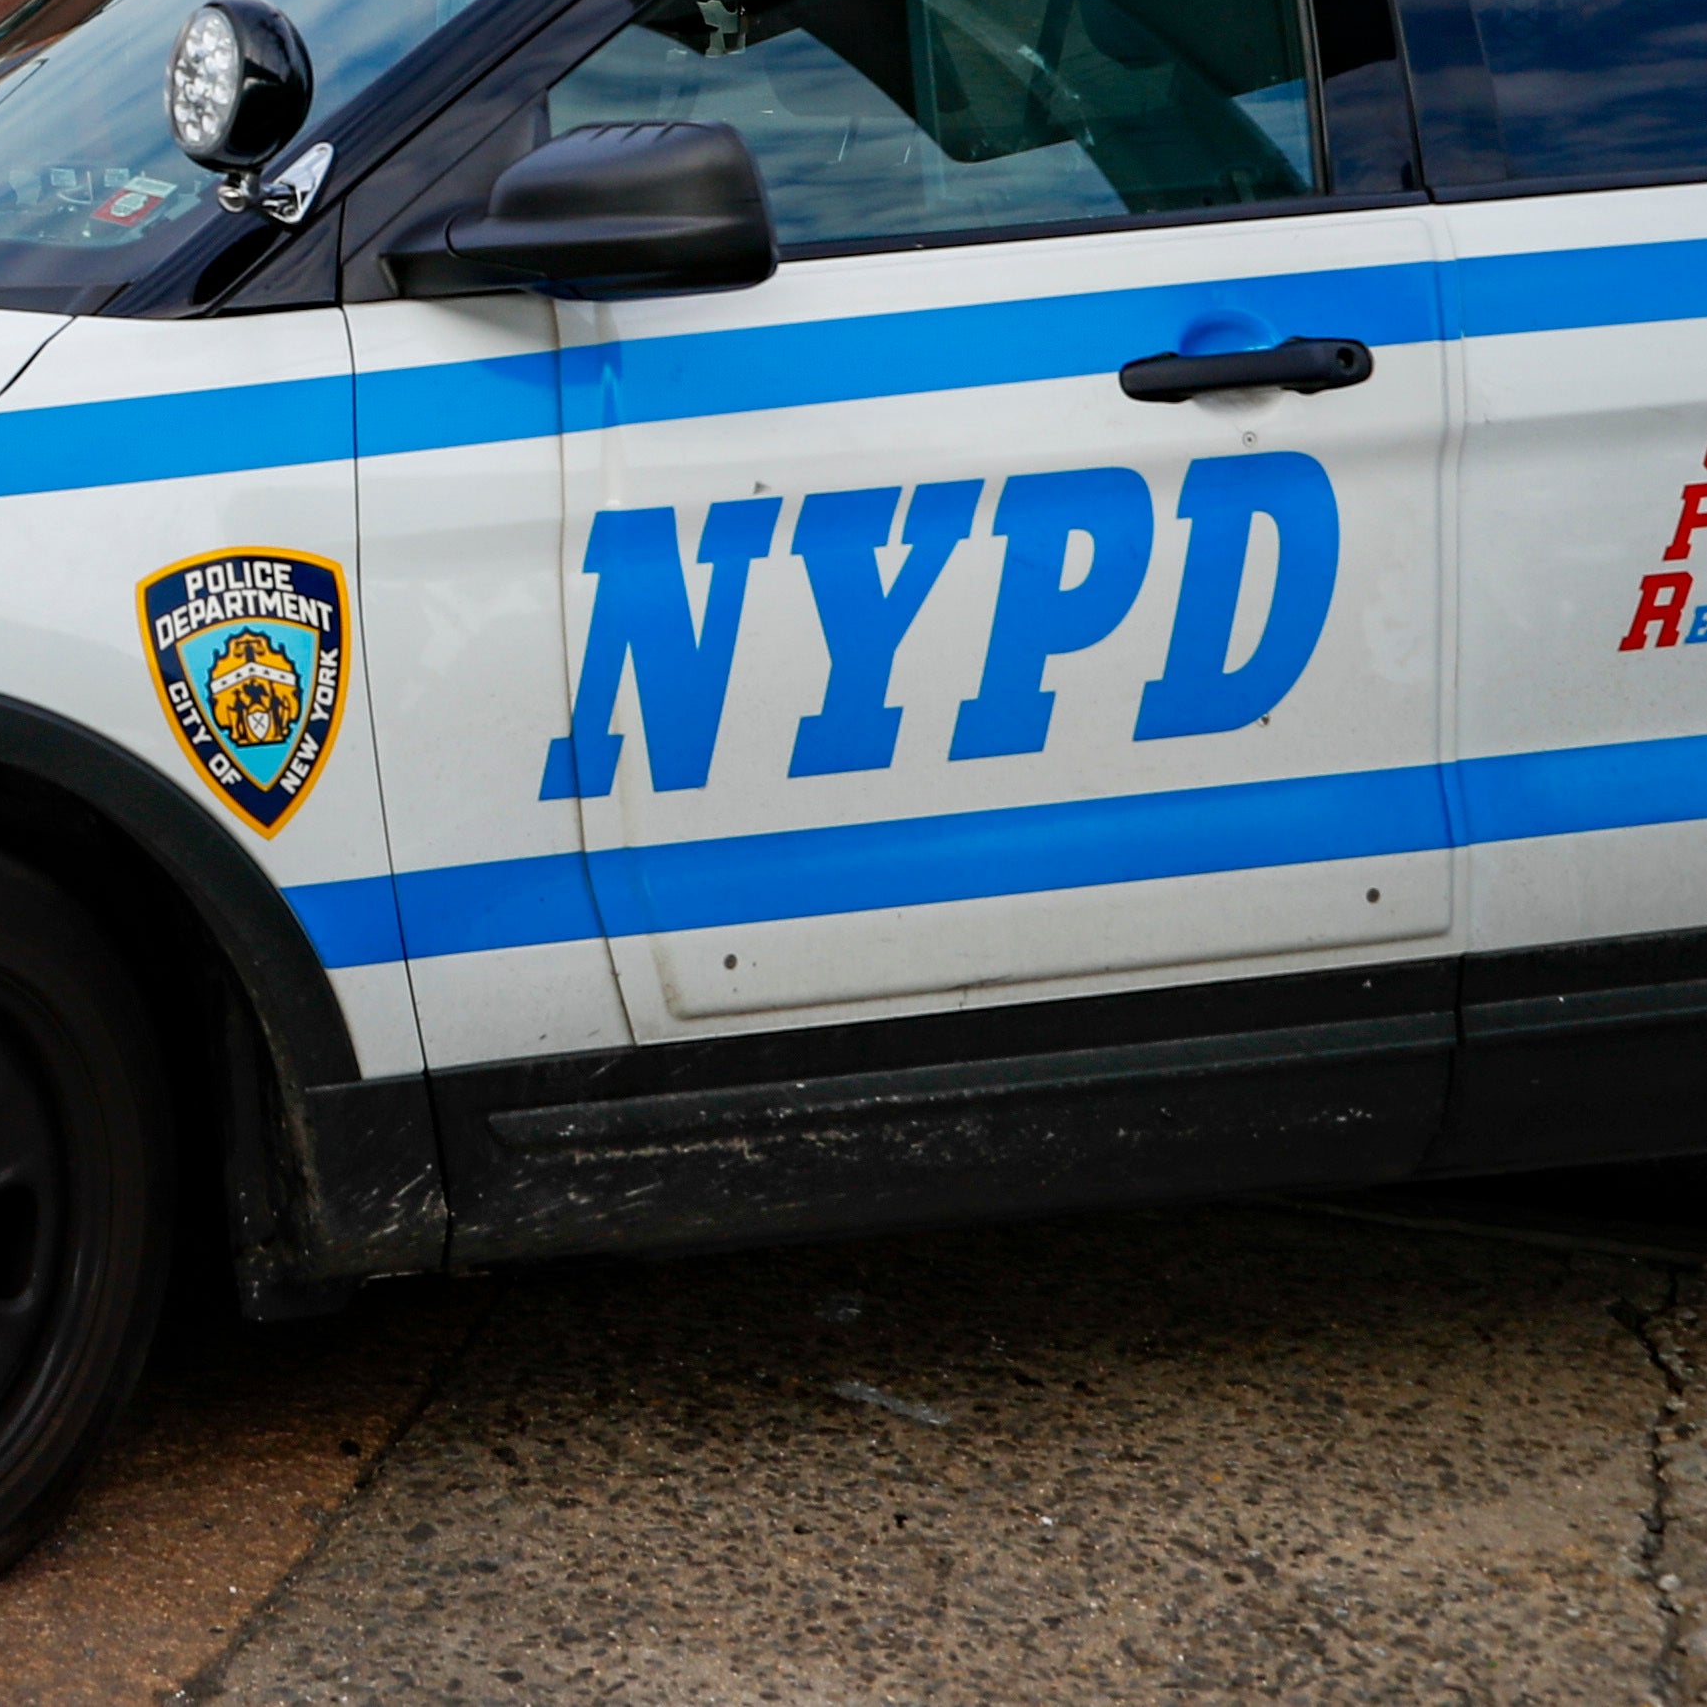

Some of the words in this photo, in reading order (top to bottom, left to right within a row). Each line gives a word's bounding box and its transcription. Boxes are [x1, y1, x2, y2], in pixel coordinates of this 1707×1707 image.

[154, 588, 334, 652] DEPARTMENT
[183, 559, 295, 602] POLICE
[537, 449, 1343, 803] NYPD
[167, 679, 213, 747] CITY
[207, 751, 243, 787] OF
[278, 731, 321, 796] NEW
[309, 647, 340, 724] YORK
